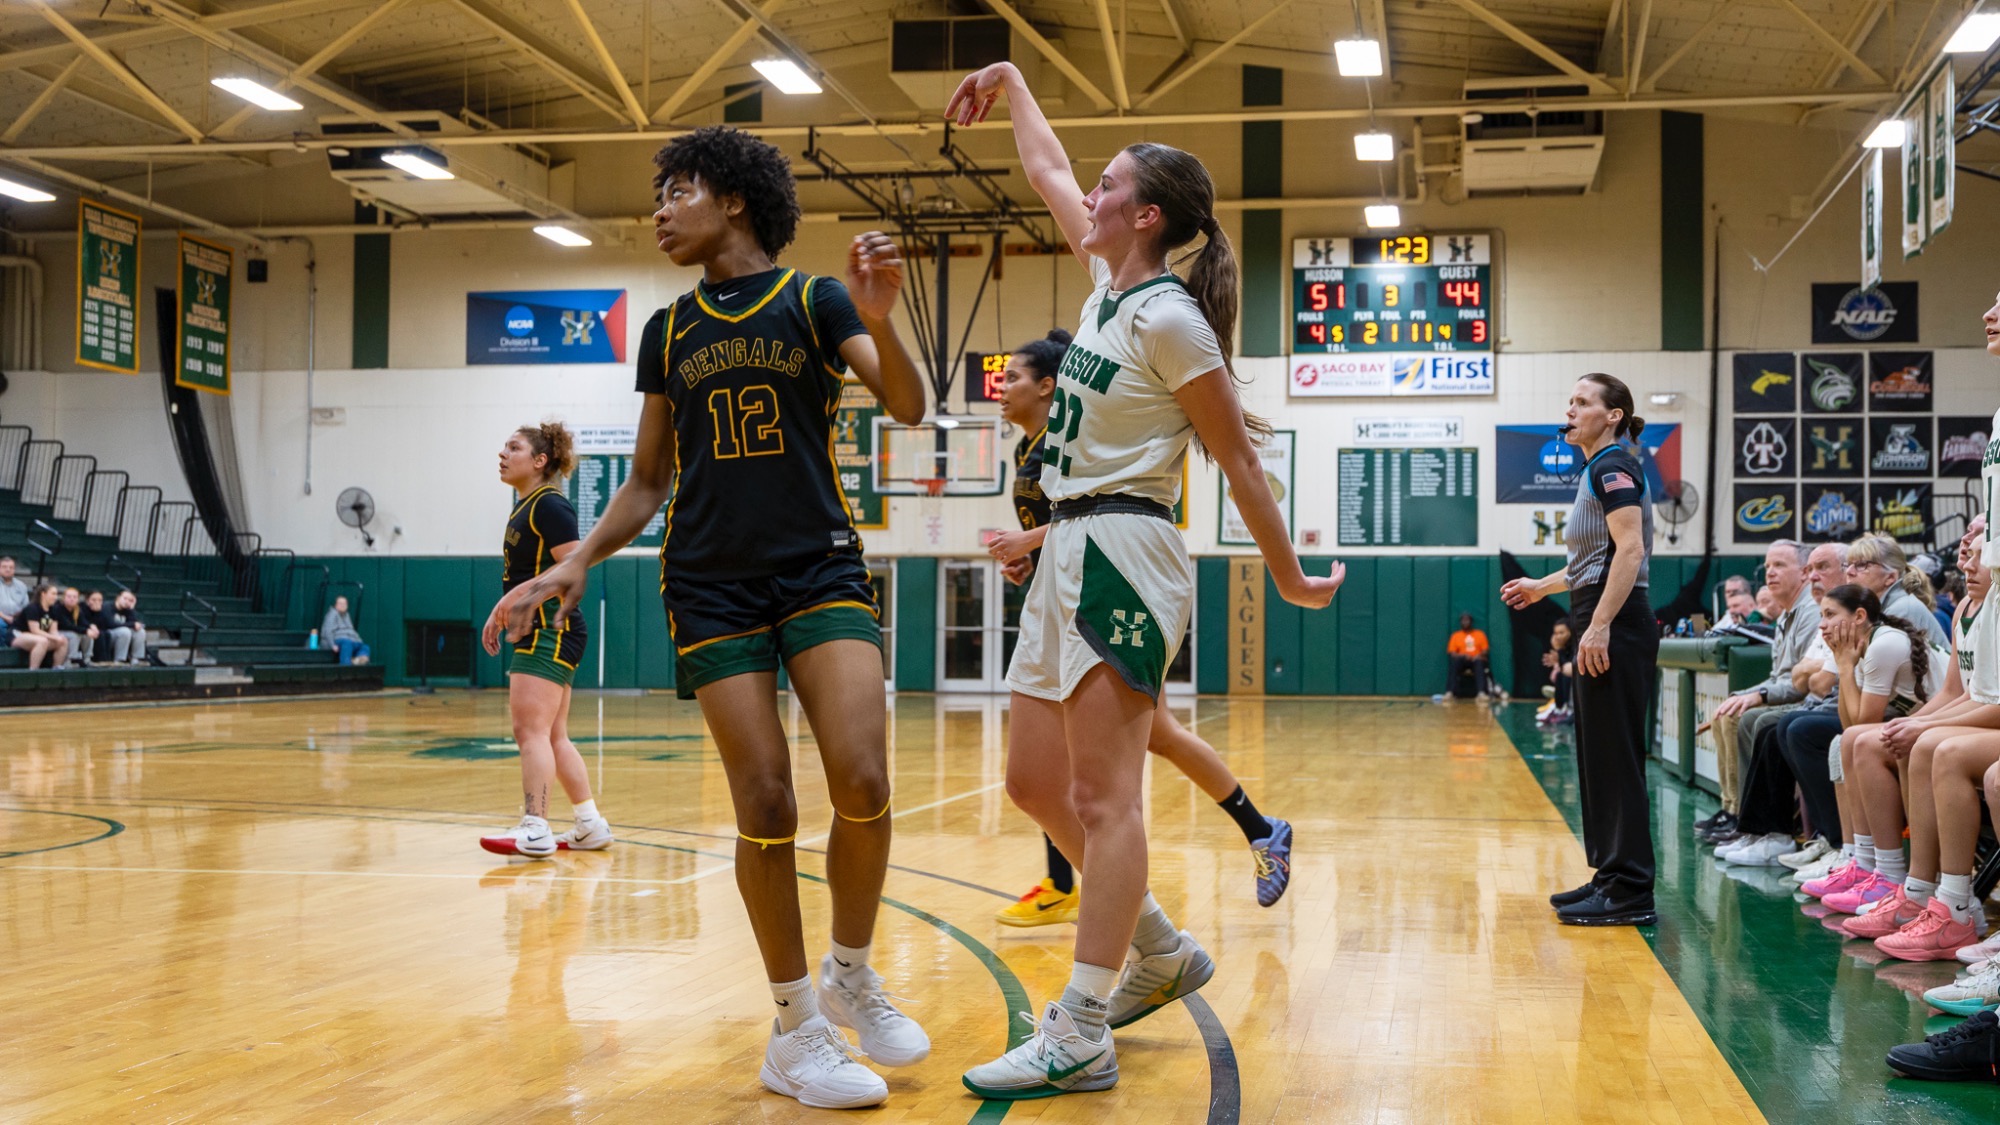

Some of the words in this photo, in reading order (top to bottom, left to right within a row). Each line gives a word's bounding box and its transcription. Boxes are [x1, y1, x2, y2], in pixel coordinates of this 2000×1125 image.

[1380, 236, 1429, 264] 1:23
[1305, 269, 1344, 282] HUSSON
[1439, 266, 1478, 280] GUEST
[1310, 283, 1345, 310] 51
[1385, 284, 1399, 307] 3
[1445, 282, 1480, 307] 44
[1297, 312, 1324, 322] FOULS
[1353, 311, 1375, 322] PLYR
[1380, 310, 1402, 321] FOUL
[1410, 310, 1427, 321] PTS
[1458, 309, 1485, 320] FOULS
[1831, 309, 1898, 325] NAC
[500, 337, 531, 346] Division
[1310, 324, 1326, 344] 4
[1363, 322, 1379, 345] 2
[1472, 320, 1487, 343] 3
[678, 337, 806, 390] BENGALS
[1321, 363, 1357, 374] SACO
[1360, 363, 1386, 374] BAY
[1431, 357, 1491, 379] First
[708, 384, 785, 460] 12
[1543, 455, 1573, 465] NCAA
[1534, 474, 1567, 485] Division
[1239, 564, 1255, 688] EAGLES
